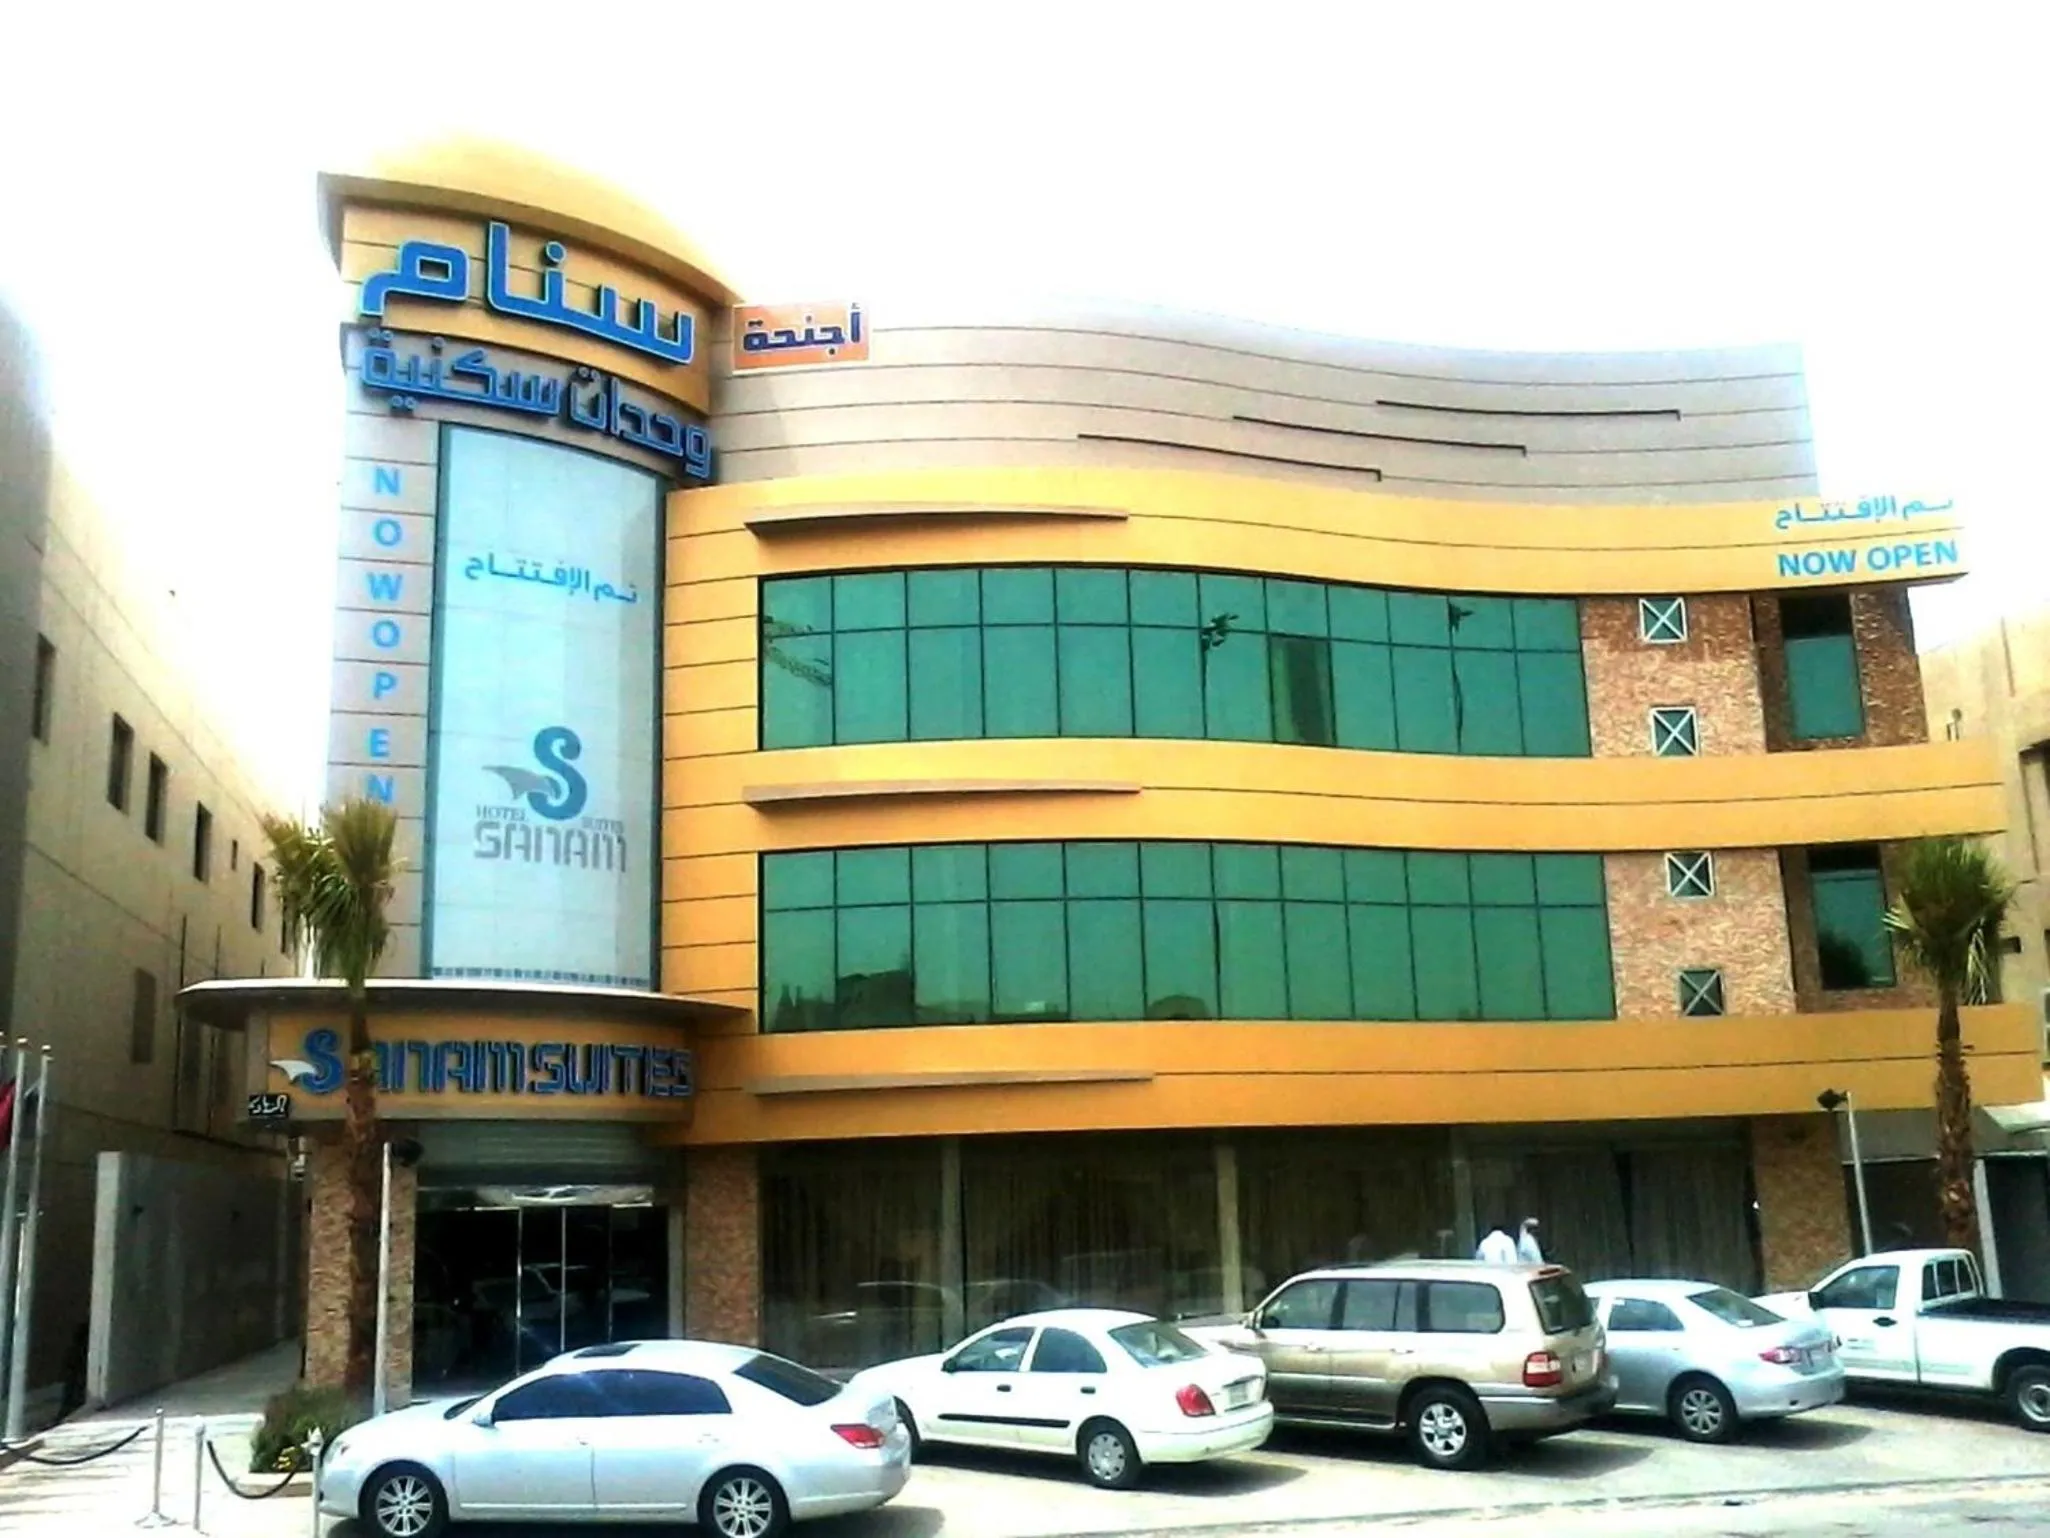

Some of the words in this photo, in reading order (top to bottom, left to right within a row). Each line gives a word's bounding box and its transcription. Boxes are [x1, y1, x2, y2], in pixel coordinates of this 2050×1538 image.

[360, 221, 694, 366] سنام
[743, 302, 861, 356] أجنحة
[362, 329, 562, 417] سكنية
[569, 365, 712, 480] وحدات
[1778, 549, 1858, 577] NOW
[1867, 539, 1958, 571] OPEN
